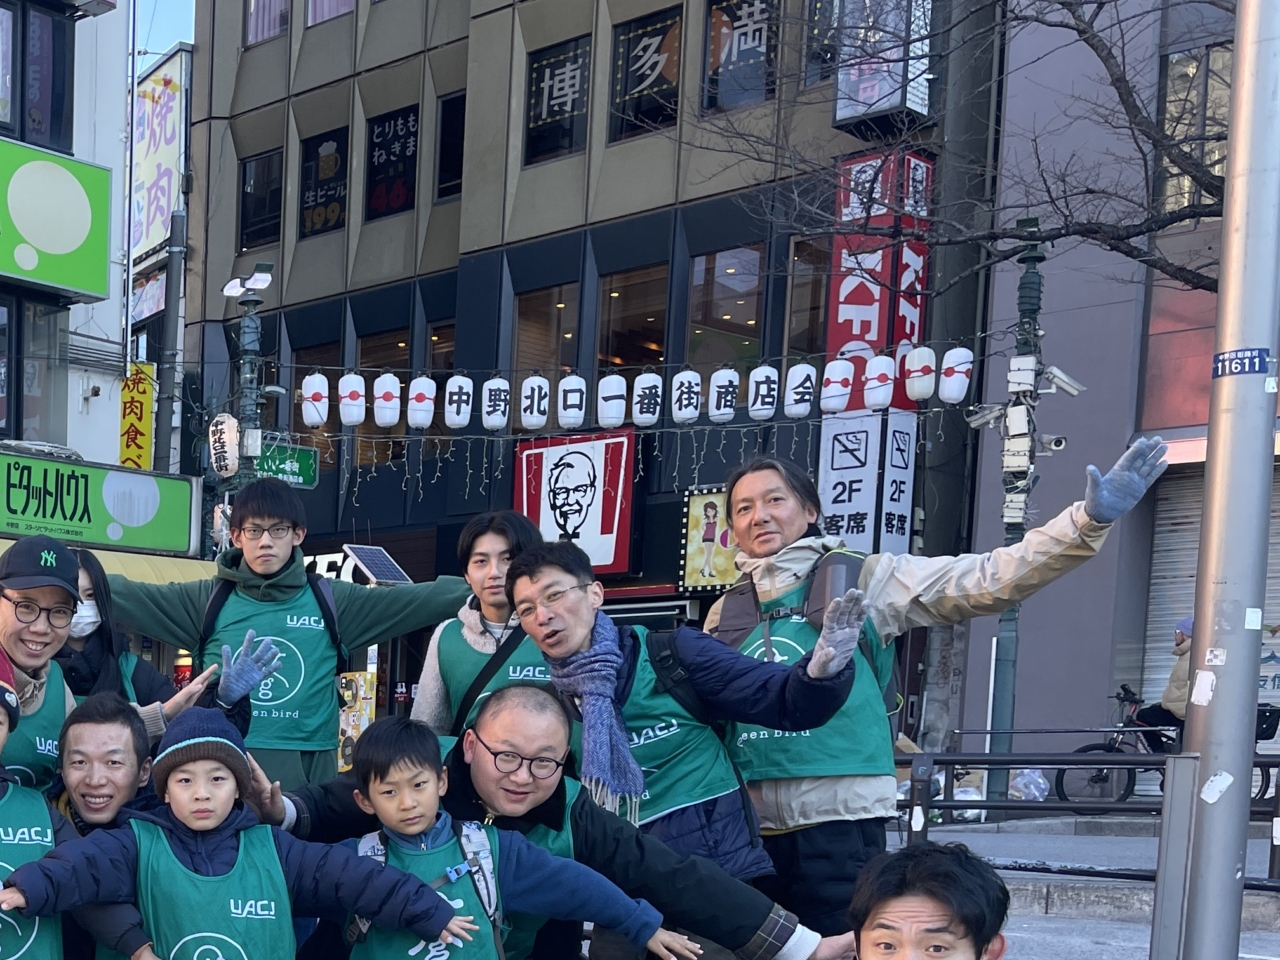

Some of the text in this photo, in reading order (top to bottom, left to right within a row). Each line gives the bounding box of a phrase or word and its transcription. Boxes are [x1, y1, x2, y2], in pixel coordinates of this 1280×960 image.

[372, 112, 418, 143] とりもも
[144, 84, 178, 241] 焼肉
[372, 135, 417, 166] ねぎま
[303, 185, 348, 208] 生ビール
[1217, 358, 1260, 376] 11611
[6, 461, 92, 524] ピタットハウス
[831, 479, 864, 504] 2F
[889, 479, 907, 503] 2F
[823, 512, 868, 537] 客席
[884, 512, 908, 536] 客席
[286, 614, 325, 631] UACJ
[271, 708, 300, 719] bird
[0, 827, 53, 846] UACJ
[230, 899, 276, 919] UACJ
